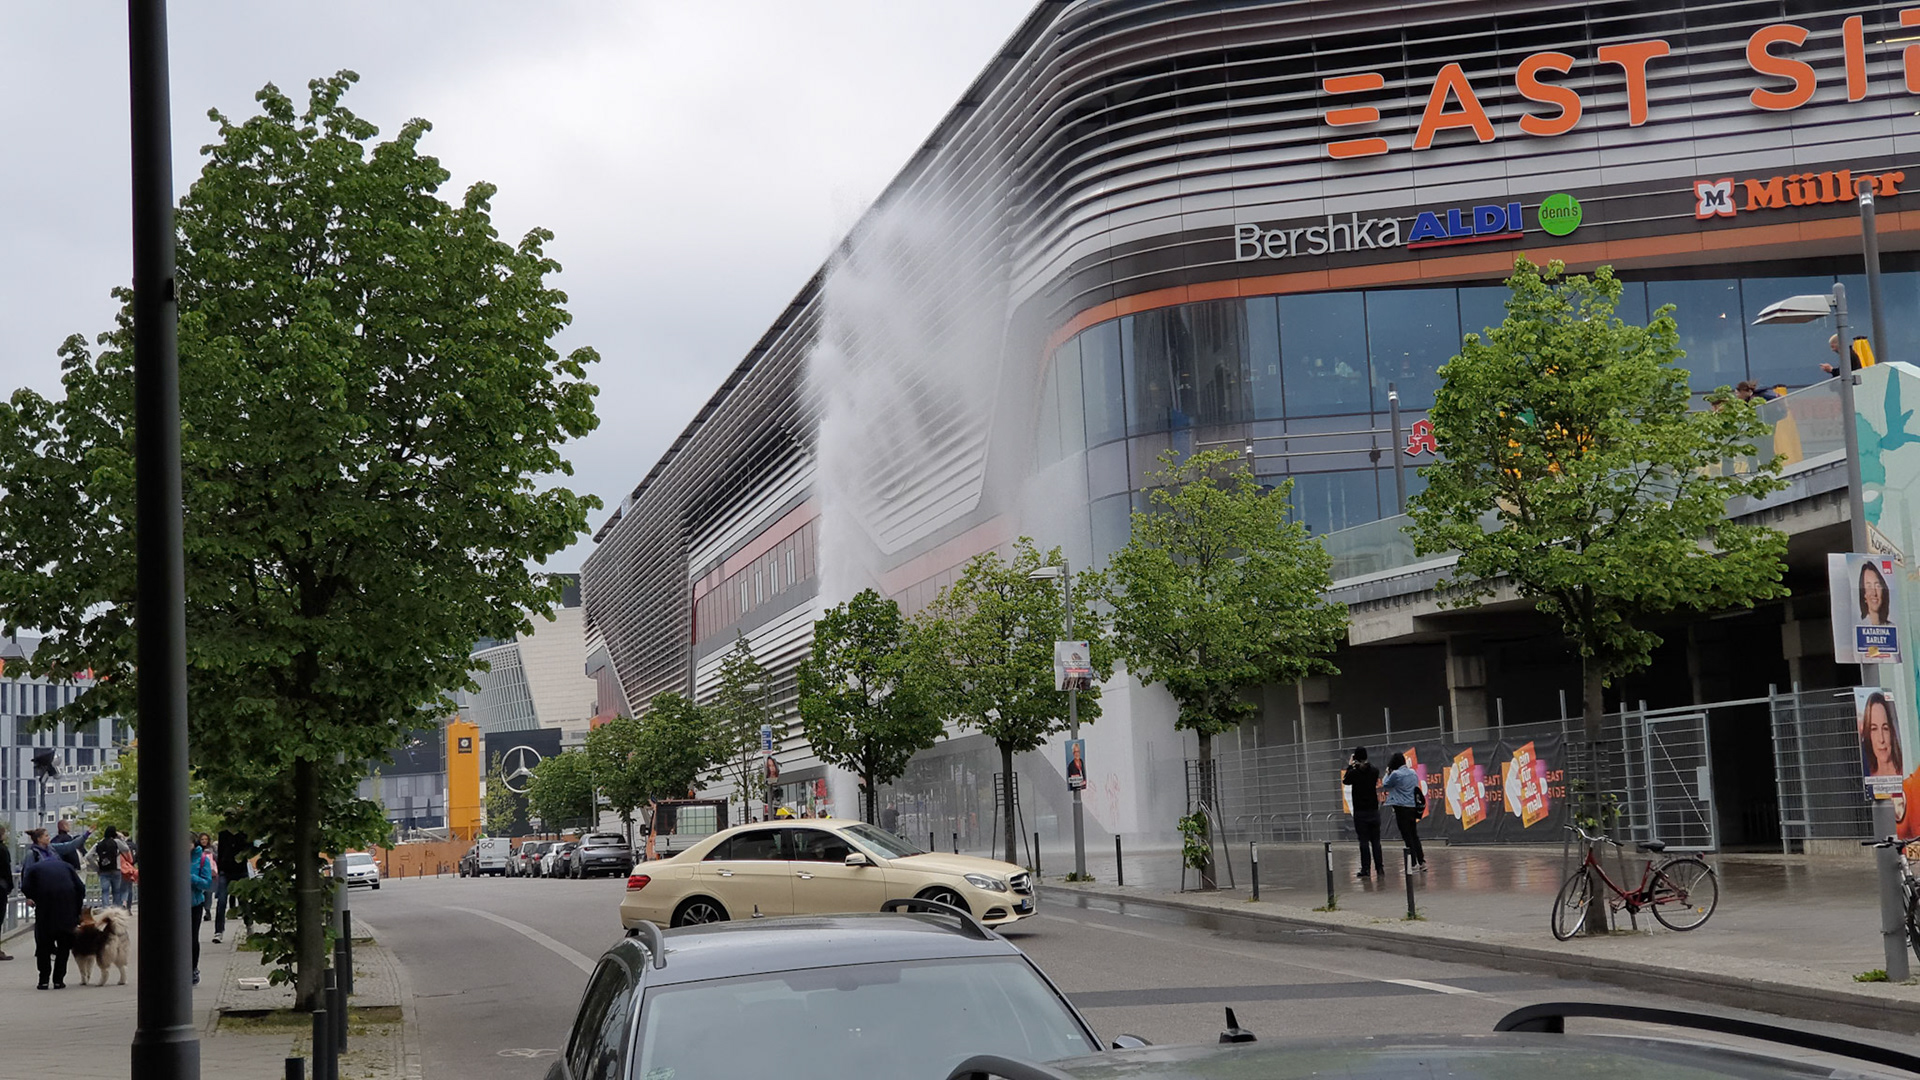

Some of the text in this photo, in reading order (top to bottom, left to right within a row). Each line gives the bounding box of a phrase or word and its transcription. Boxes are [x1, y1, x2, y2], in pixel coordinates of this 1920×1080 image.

[1322, 39, 1671, 160] EAST
[1744, 169, 1905, 211] Müller
[1408, 202, 1524, 241] ALDI
[1234, 212, 1402, 261] Bershka
[1866, 636, 1887, 644] BARLEY
[1426, 773, 1442, 785] EAST
[1484, 775, 1500, 786] EAST
[1546, 770, 1564, 782] EAST
[1428, 788, 1444, 800] SIDE
[1486, 790, 1502, 802] SIDE
[1548, 786, 1566, 798] SIDE
[1526, 793, 1543, 814] mall
